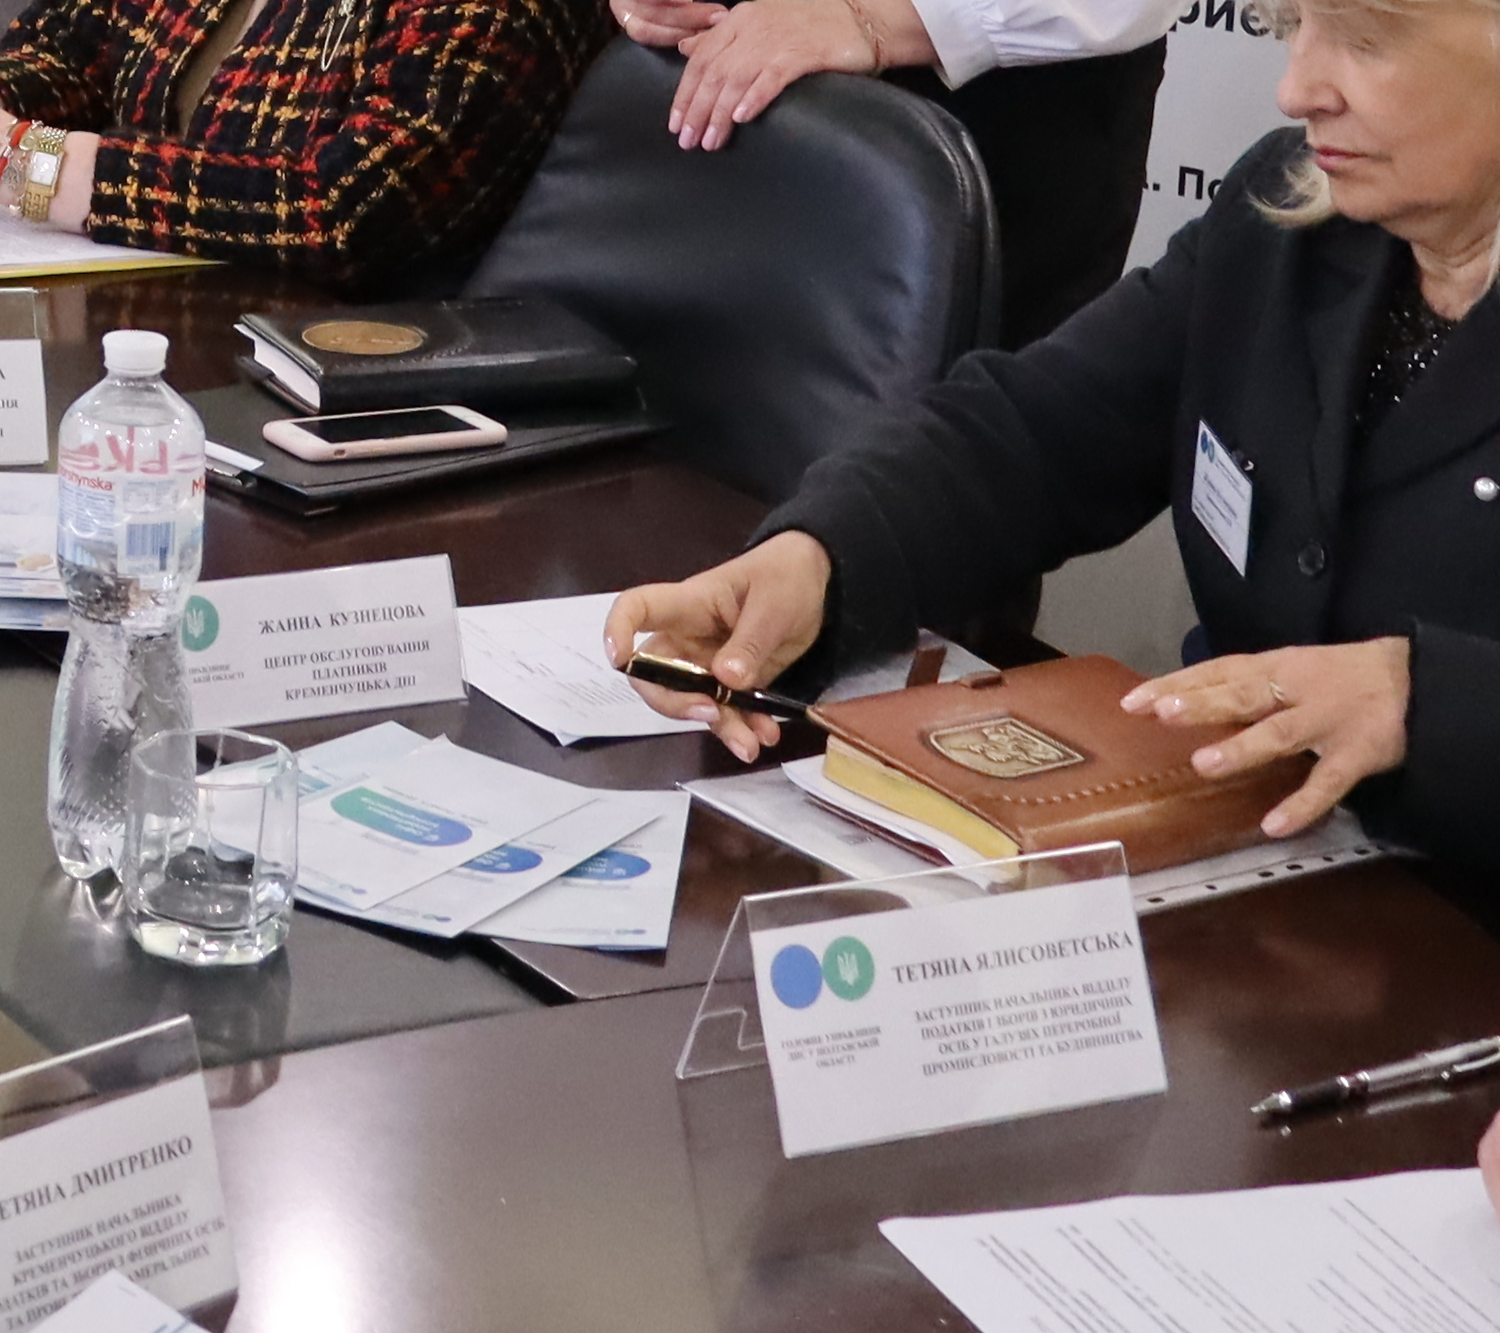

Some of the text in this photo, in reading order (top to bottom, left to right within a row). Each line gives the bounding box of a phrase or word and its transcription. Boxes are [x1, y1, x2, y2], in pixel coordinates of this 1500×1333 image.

[258, 604, 426, 634] ЖАННА КУЗНЕЦОВА
[264, 640, 430, 670] ЦЕНТР ОБСЛУГОВУВАННЯ
[312, 662, 387, 681] ПЛАТНИКІВ
[285, 680, 391, 701] КРЕМЕНЧУЦЬКА
[891, 958, 972, 984] ТЕТЯНА
[70, 1135, 194, 1198] ДМИТРЕНКО
